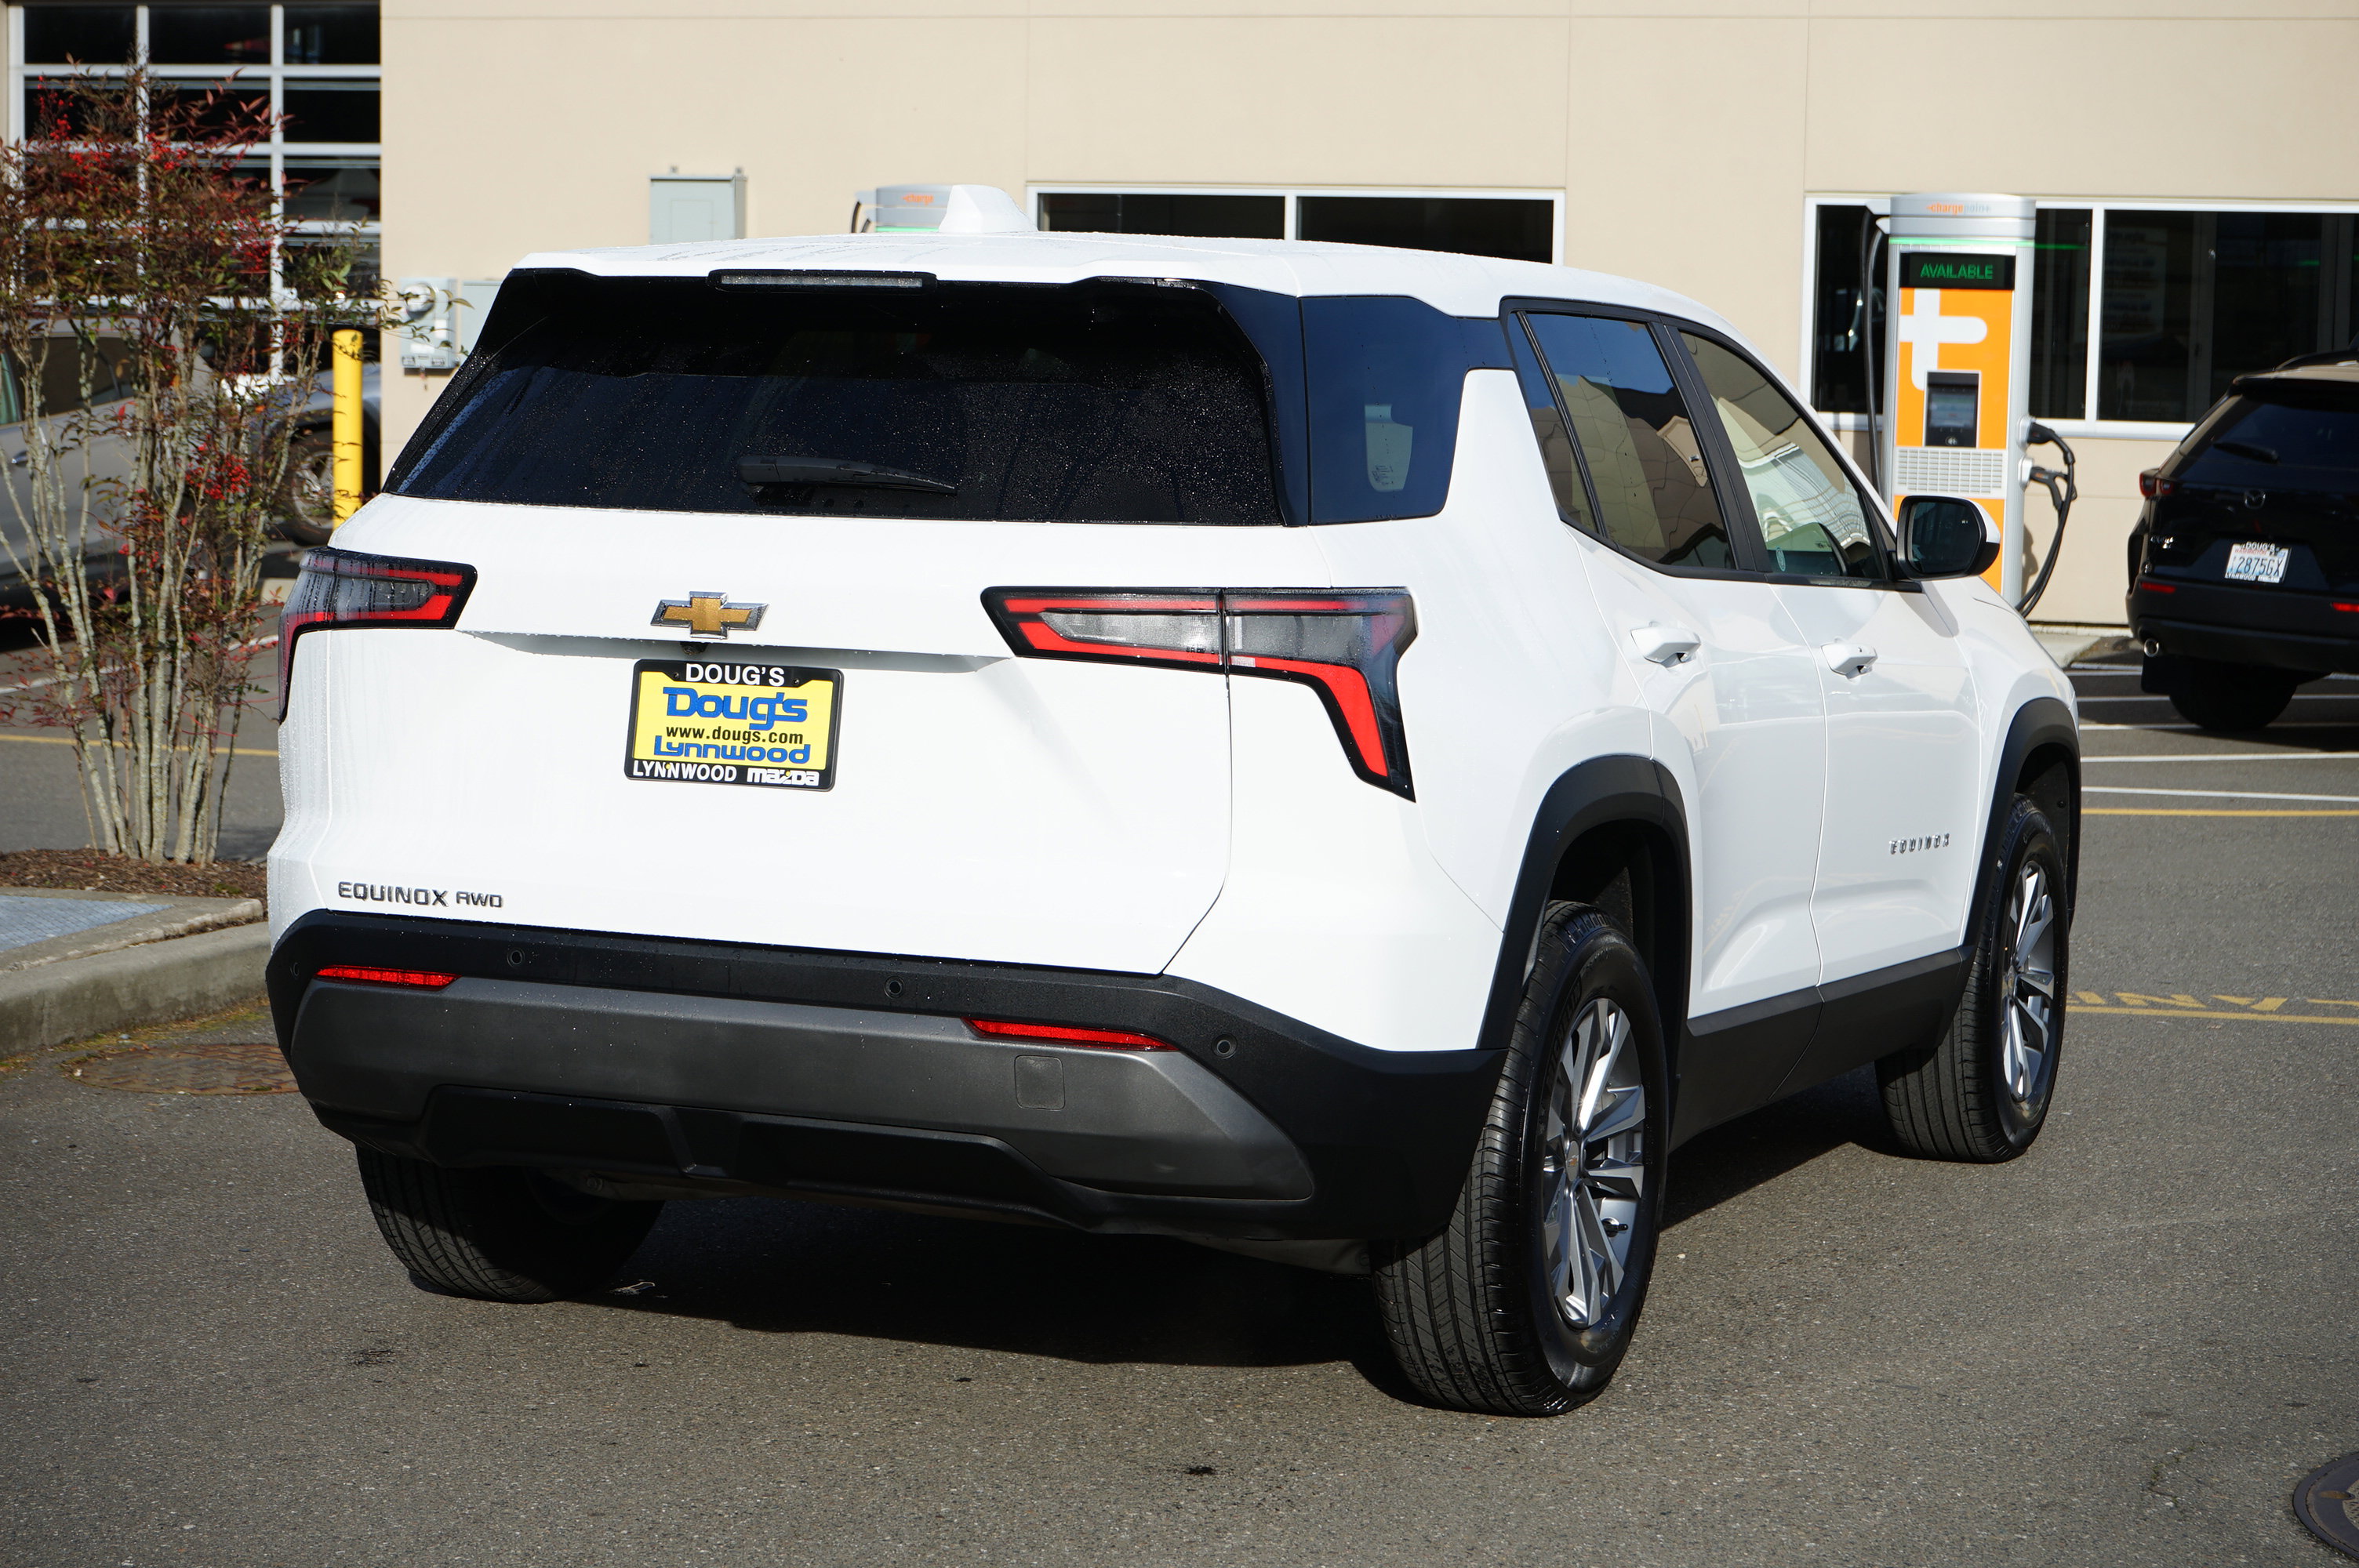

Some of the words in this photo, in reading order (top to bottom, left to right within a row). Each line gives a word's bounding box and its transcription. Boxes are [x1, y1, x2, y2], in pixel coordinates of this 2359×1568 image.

[1920, 263, 1994, 279] AVAILABLE
[685, 663, 785, 686] DOUG'S
[663, 687, 808, 731] Doug's
[666, 726, 803, 744] www.dougs.com
[653, 735, 811, 764] Lynnwood
[633, 760, 737, 782] LYNNWOOD
[747, 768, 820, 786] mazda
[1888, 833, 1950, 855] EQUINOX
[339, 881, 449, 907] EQUINOX
[456, 891, 504, 908] AWD
